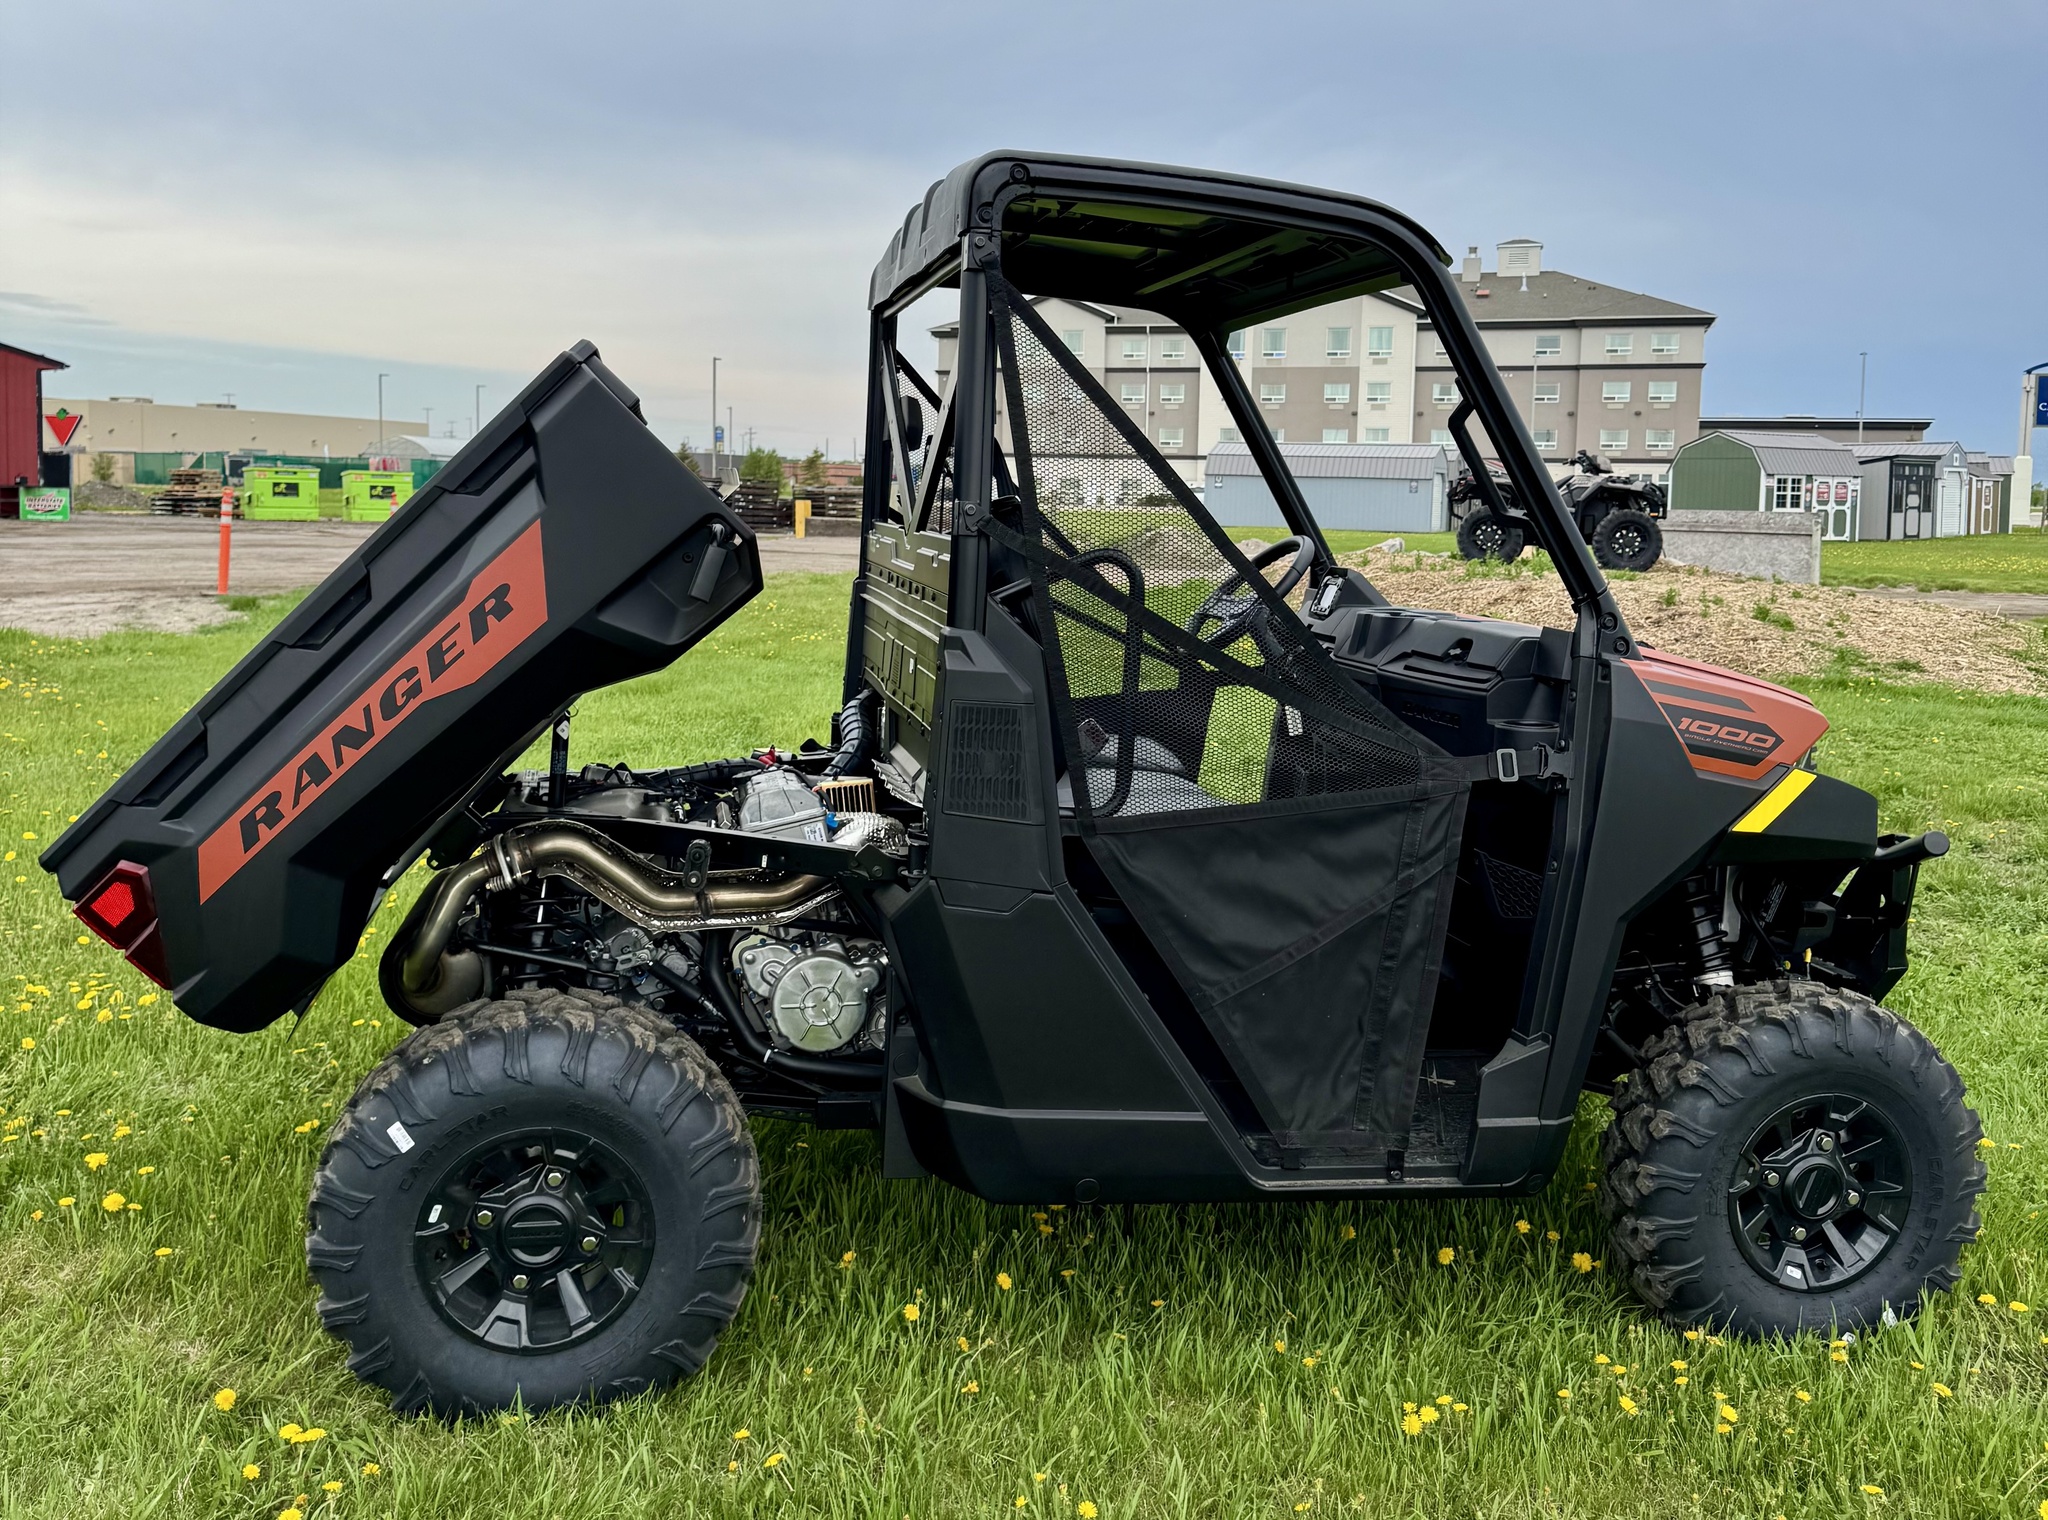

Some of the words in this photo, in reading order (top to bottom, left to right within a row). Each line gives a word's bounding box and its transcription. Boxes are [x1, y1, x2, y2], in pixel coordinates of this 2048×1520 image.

[239, 583, 514, 854] RANGER
[1401, 700, 1460, 728] RANGER
[1678, 717, 1776, 748] 1000
[1684, 733, 1711, 742] SINGLE
[1713, 739, 1751, 752] OVERHEAD
[1752, 747, 1768, 755] CAM
[400, 1105, 509, 1191] CARLSTAR
[1904, 1157, 1944, 1271] CARLSTAR
